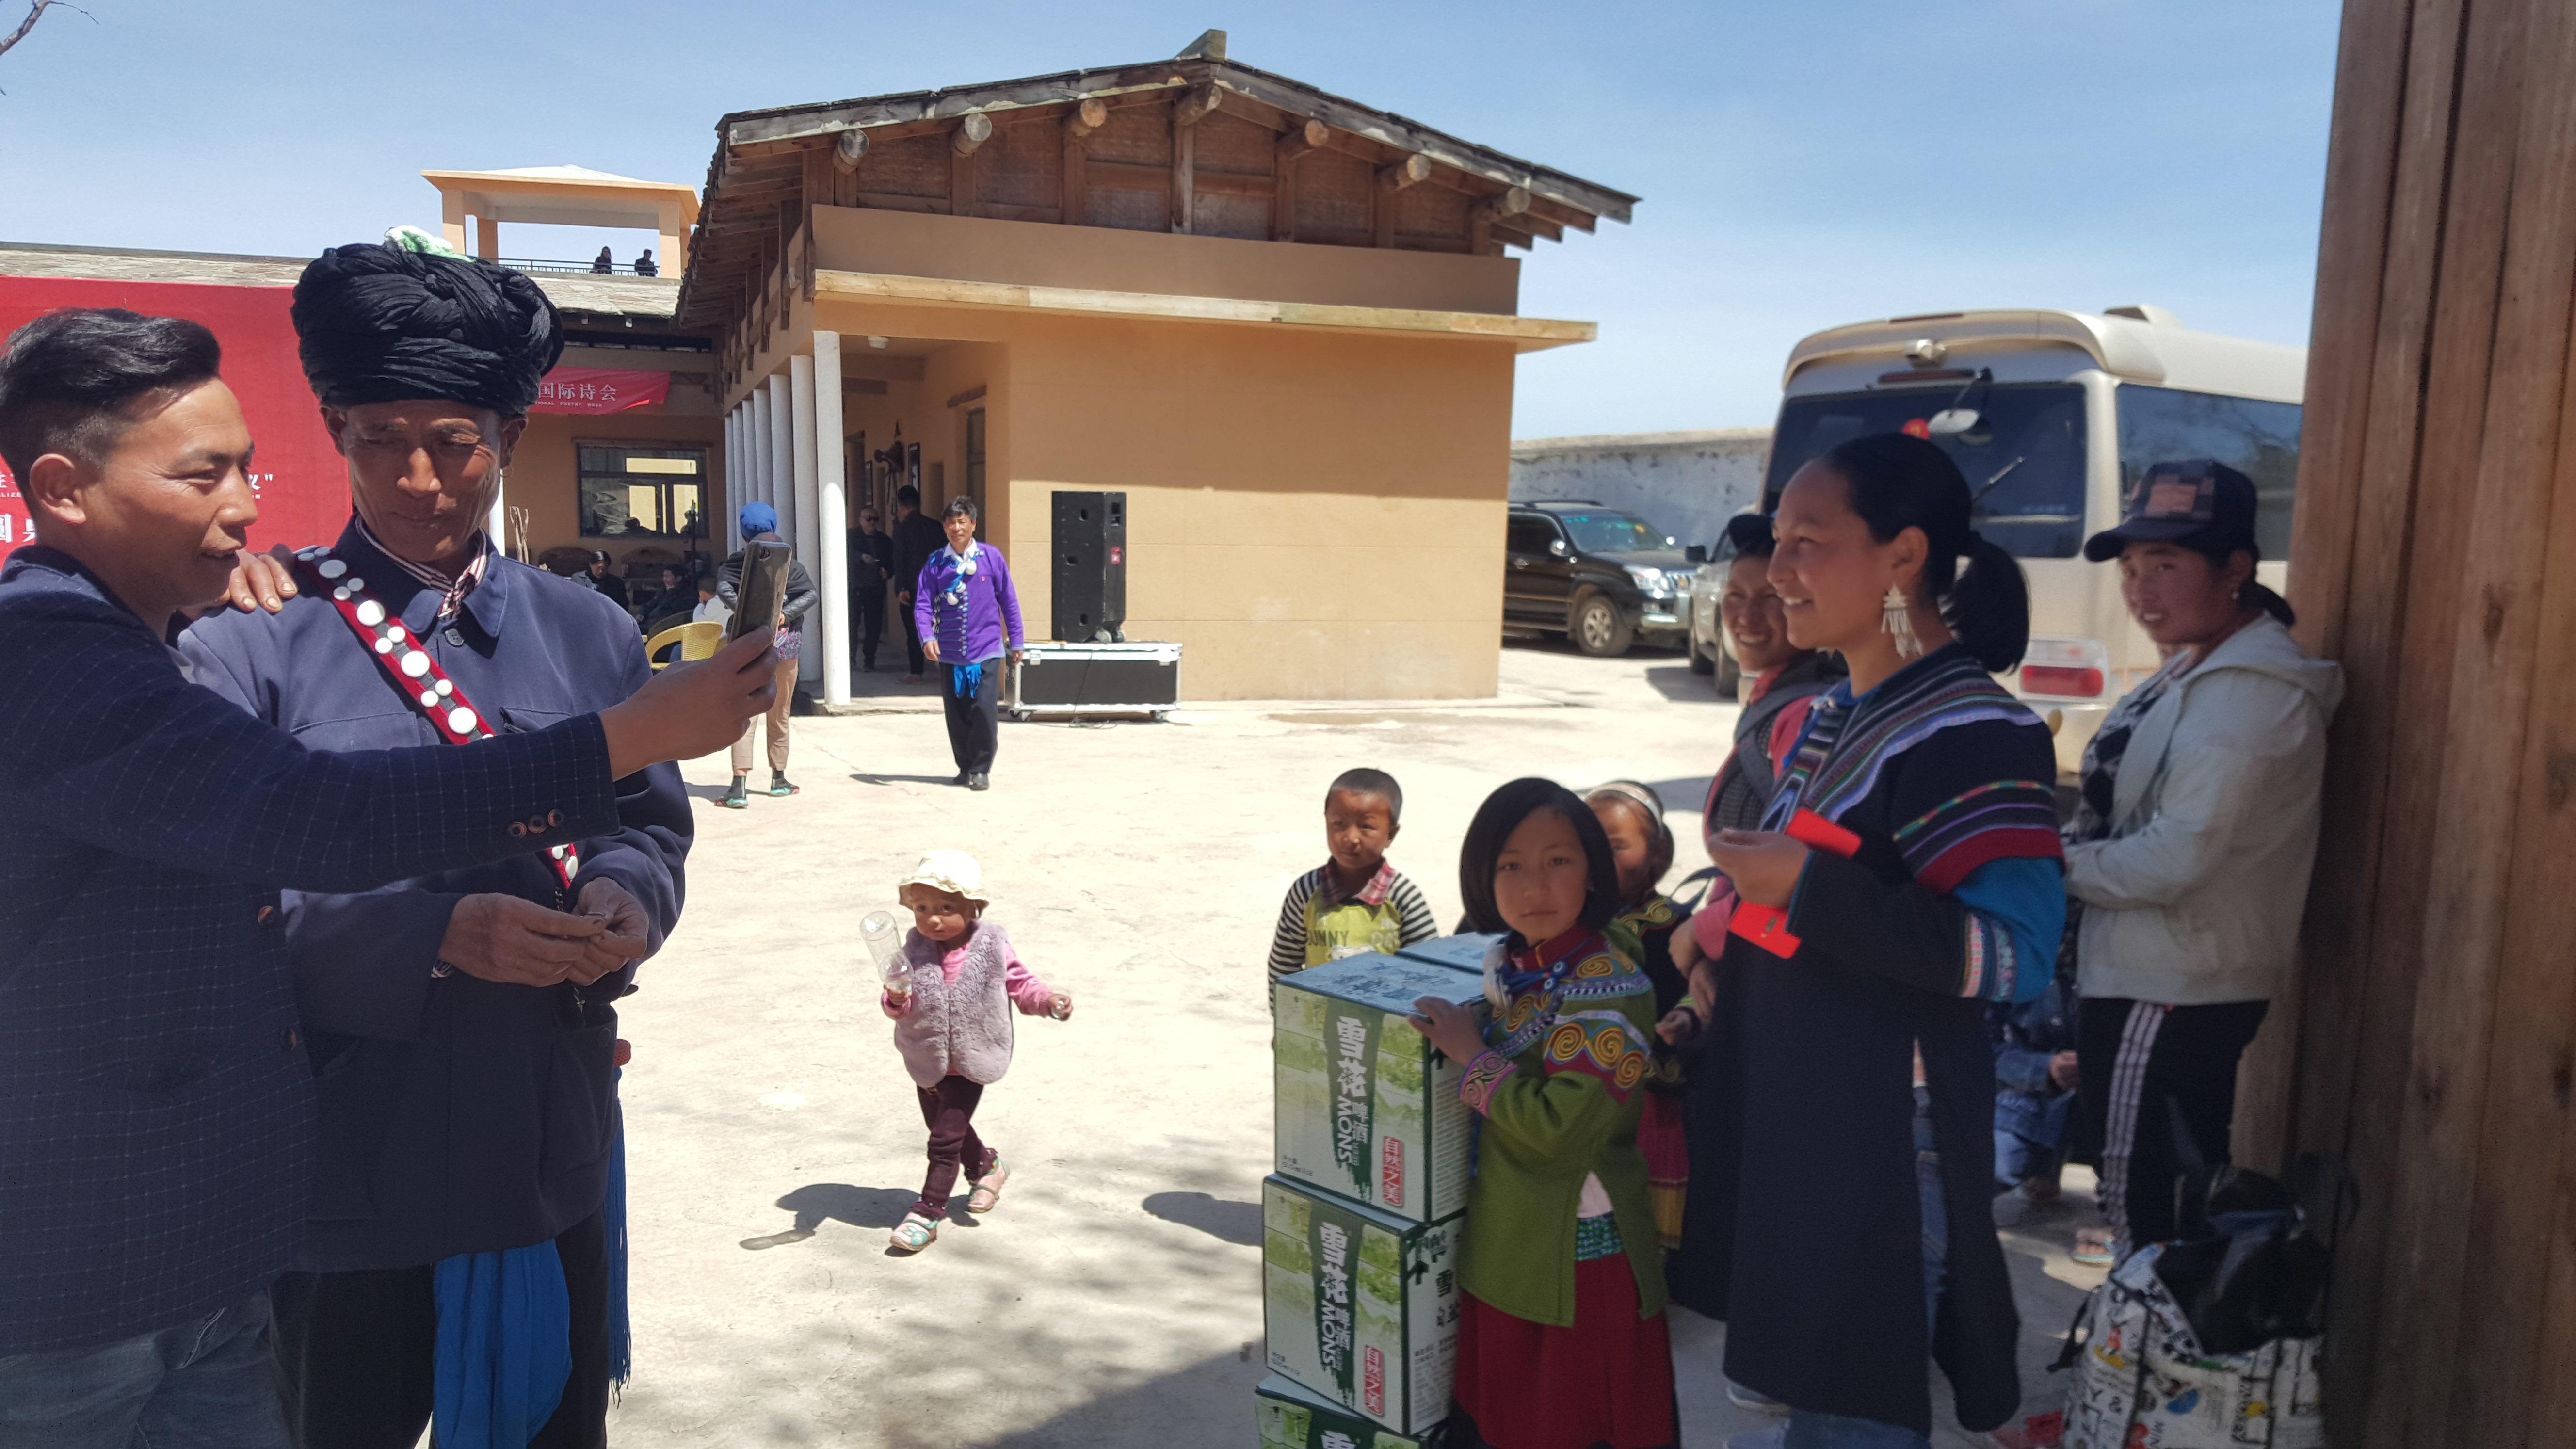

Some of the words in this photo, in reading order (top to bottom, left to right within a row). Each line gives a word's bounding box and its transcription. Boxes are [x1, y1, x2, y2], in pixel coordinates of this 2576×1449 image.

[538, 382, 617, 401] 国际诗会
[1337, 1095, 1353, 1164] SNOW
[1321, 1299, 1336, 1368] SNOW
